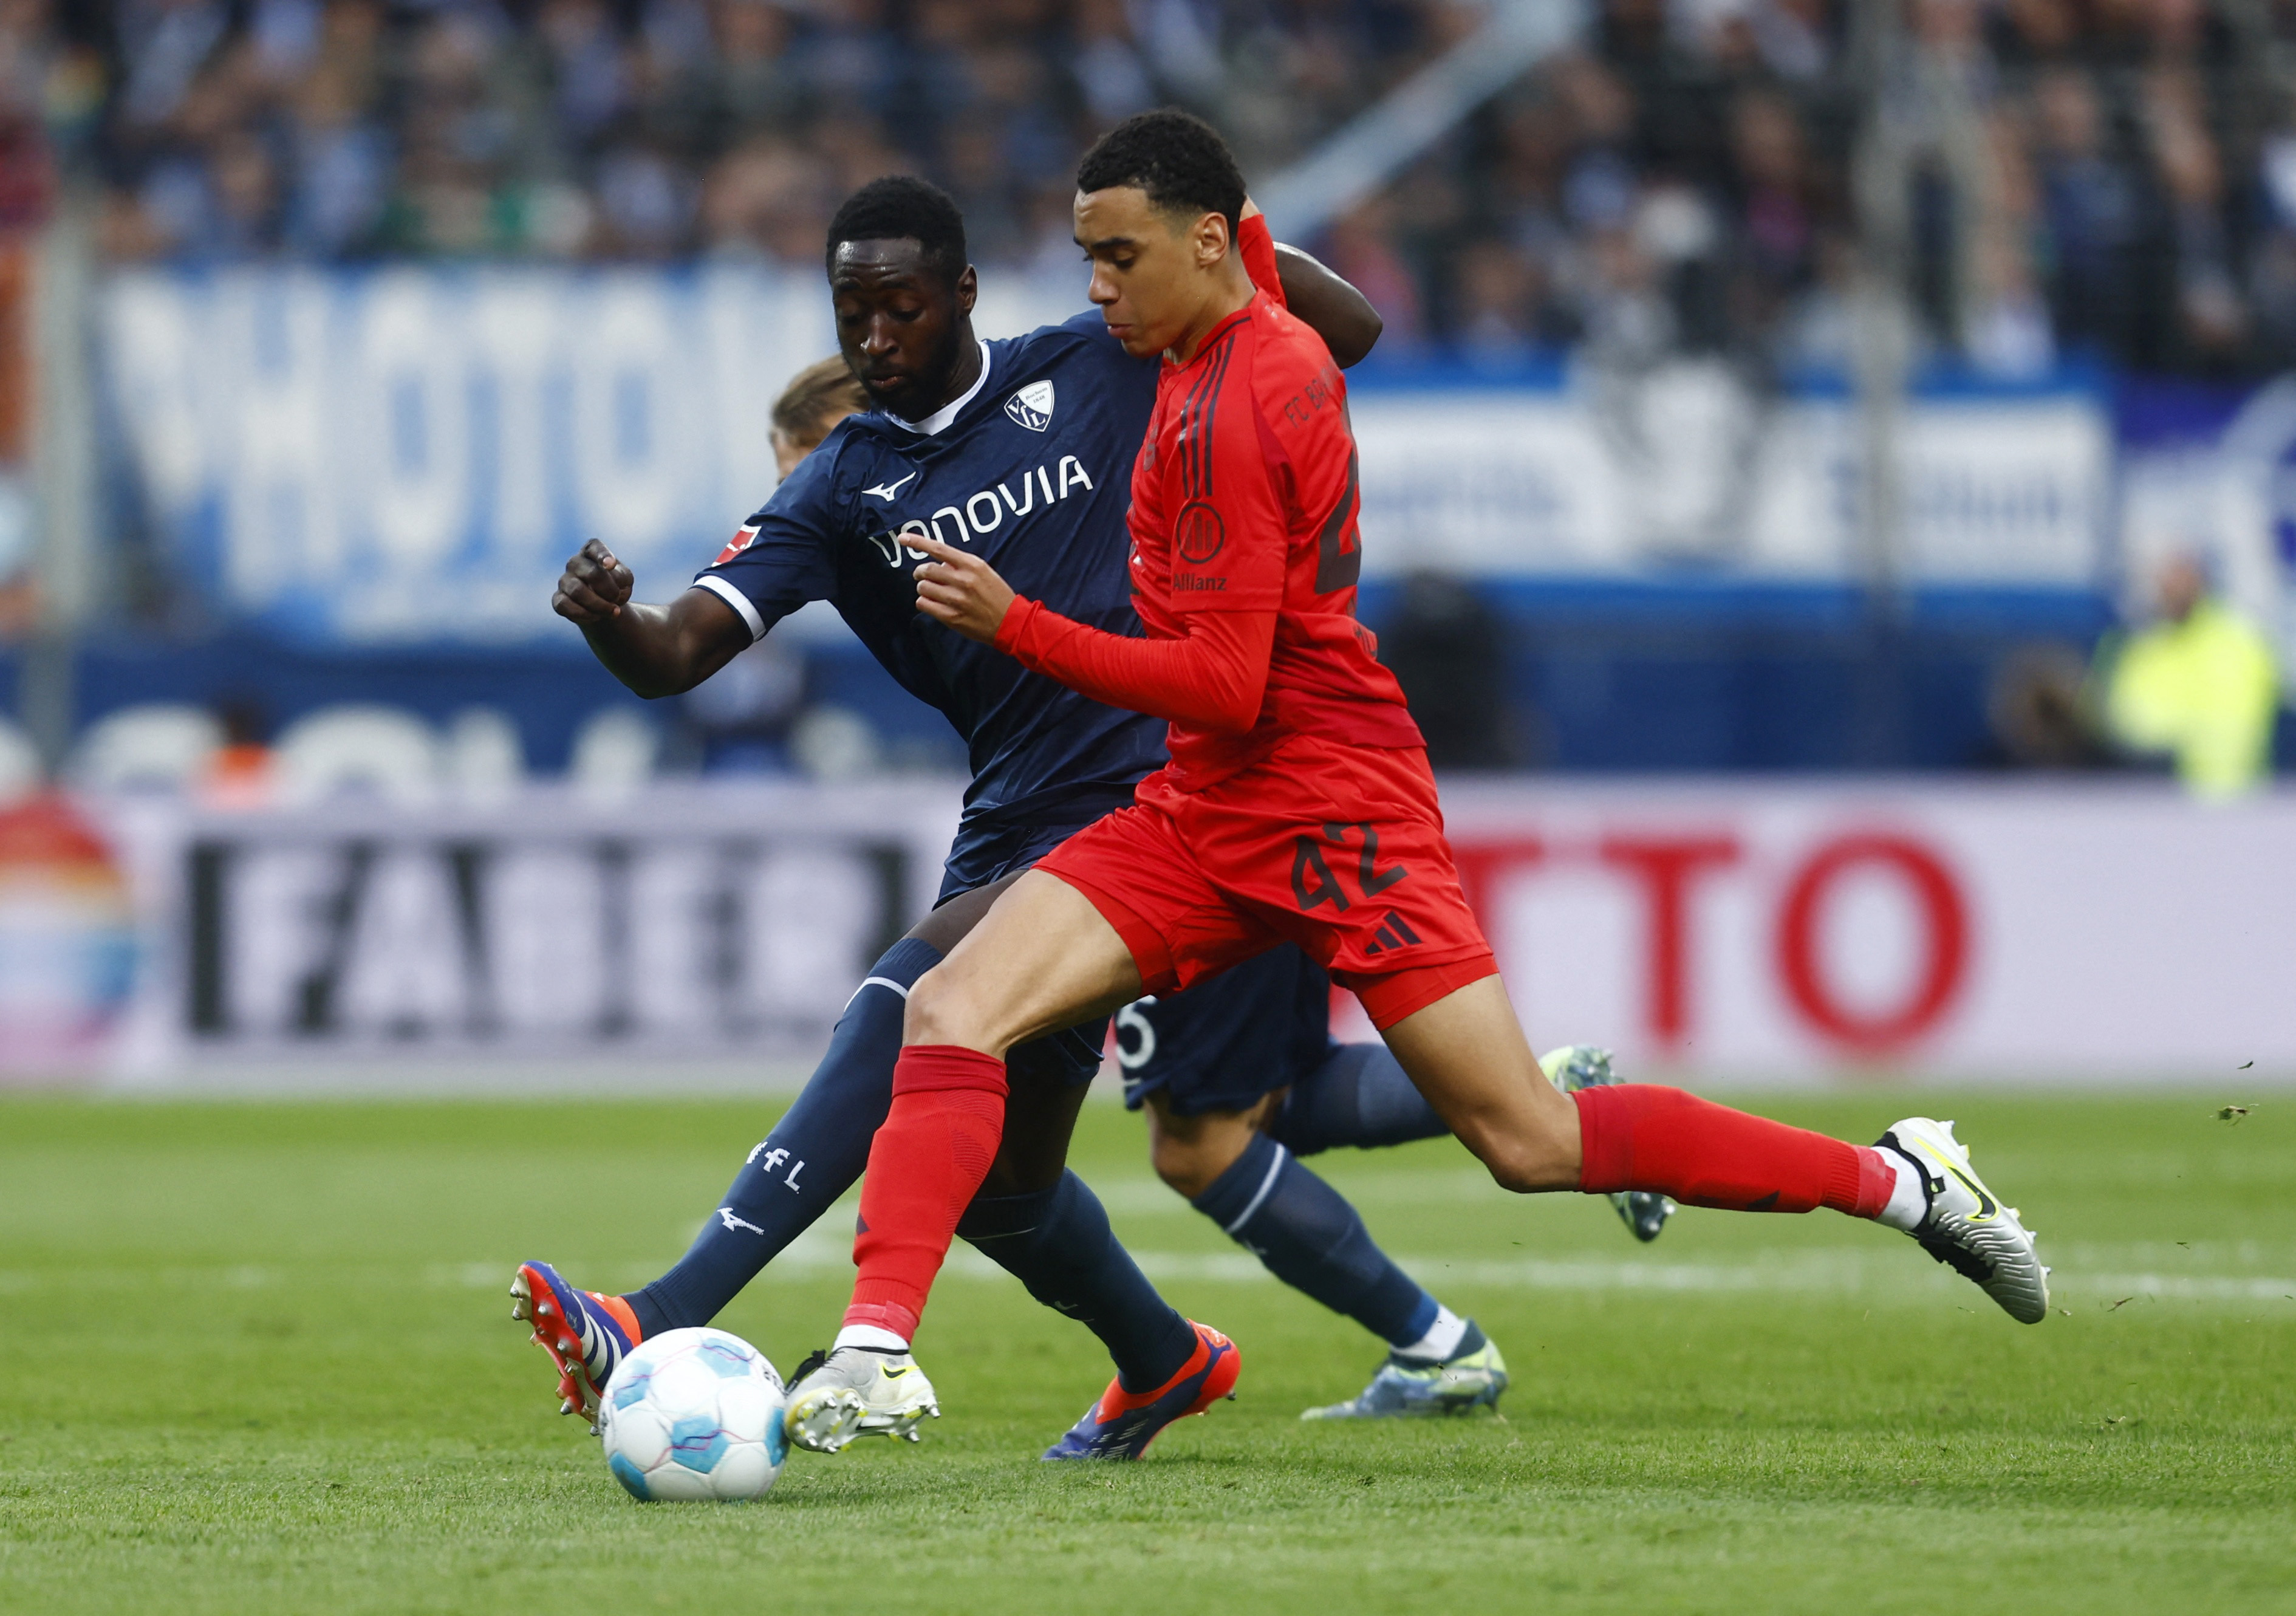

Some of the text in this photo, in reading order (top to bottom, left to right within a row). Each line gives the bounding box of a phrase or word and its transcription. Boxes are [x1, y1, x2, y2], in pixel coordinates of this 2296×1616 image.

[1025, 386, 1048, 400] Bochum
[1033, 394, 1045, 404] 1848
[1007, 399, 1046, 427] VfL
[1285, 396, 1310, 428] FC
[1174, 573, 1227, 591] Allianz
[1290, 821, 1409, 912] 42
[240, 844, 866, 1027] FABER
[1449, 829, 1977, 1057] TTO
